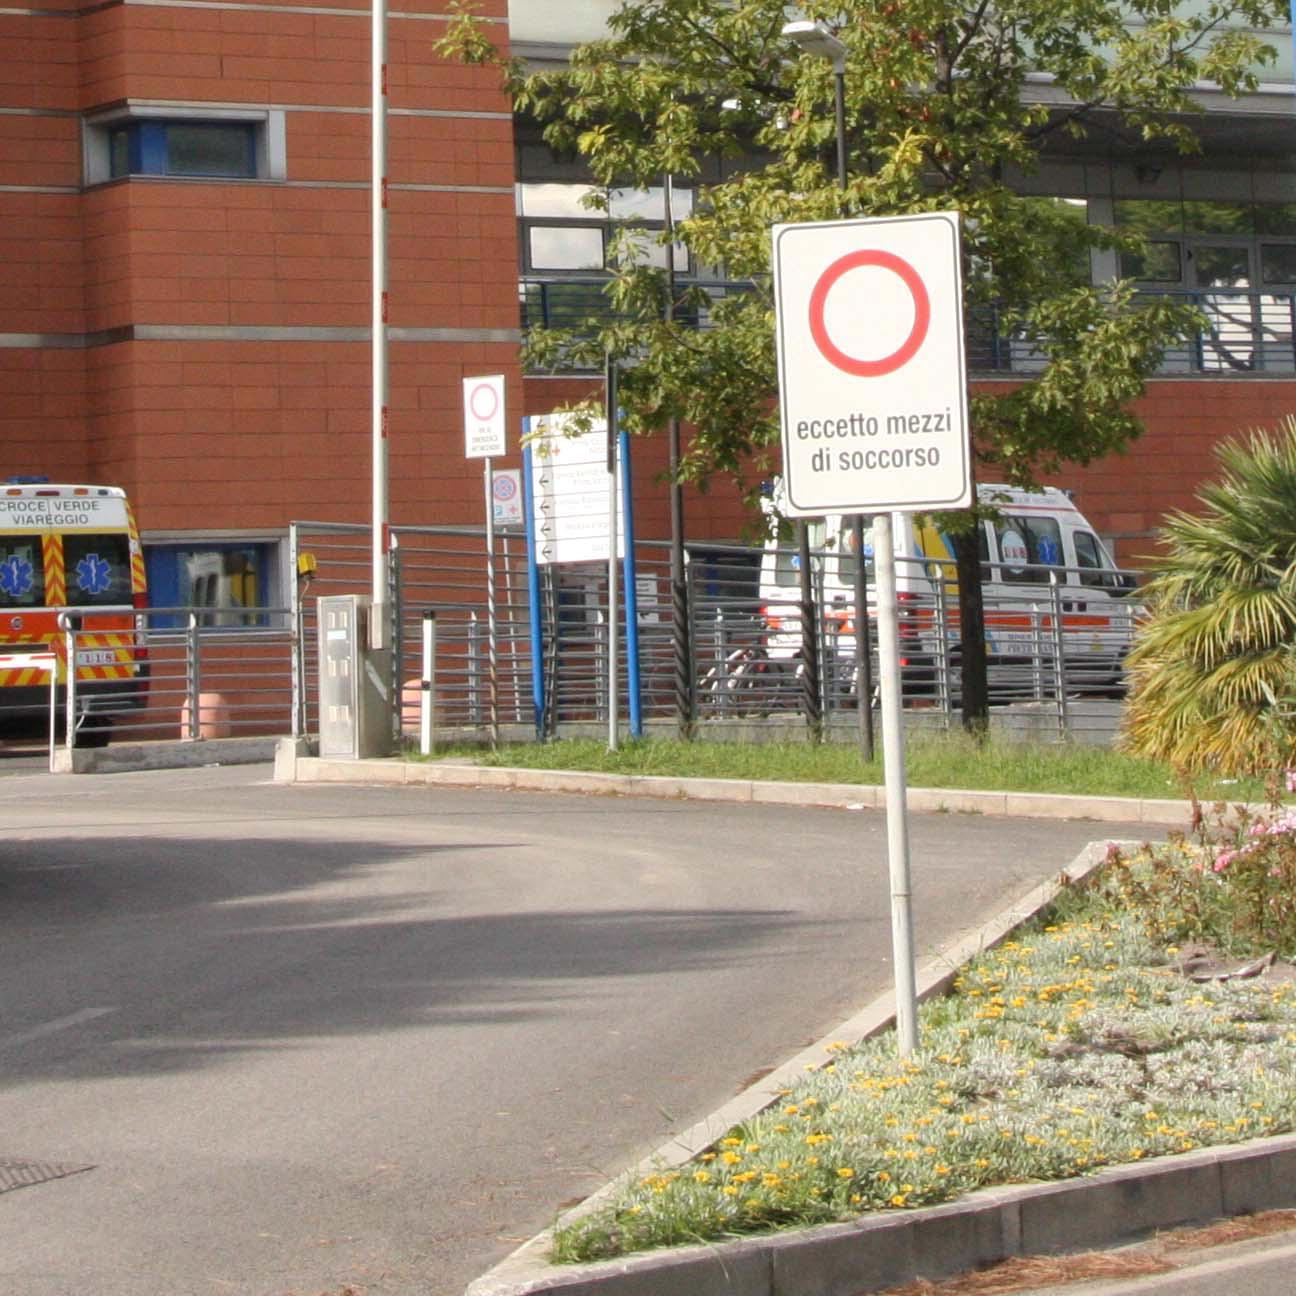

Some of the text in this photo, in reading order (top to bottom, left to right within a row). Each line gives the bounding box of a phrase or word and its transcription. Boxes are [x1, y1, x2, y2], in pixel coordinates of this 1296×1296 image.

[797, 406, 952, 440] eccetto mezzi
[811, 446, 940, 472] di soccorso
[53, 500, 100, 511] VERDE
[12, 514, 89, 525] VIAREGGIO
